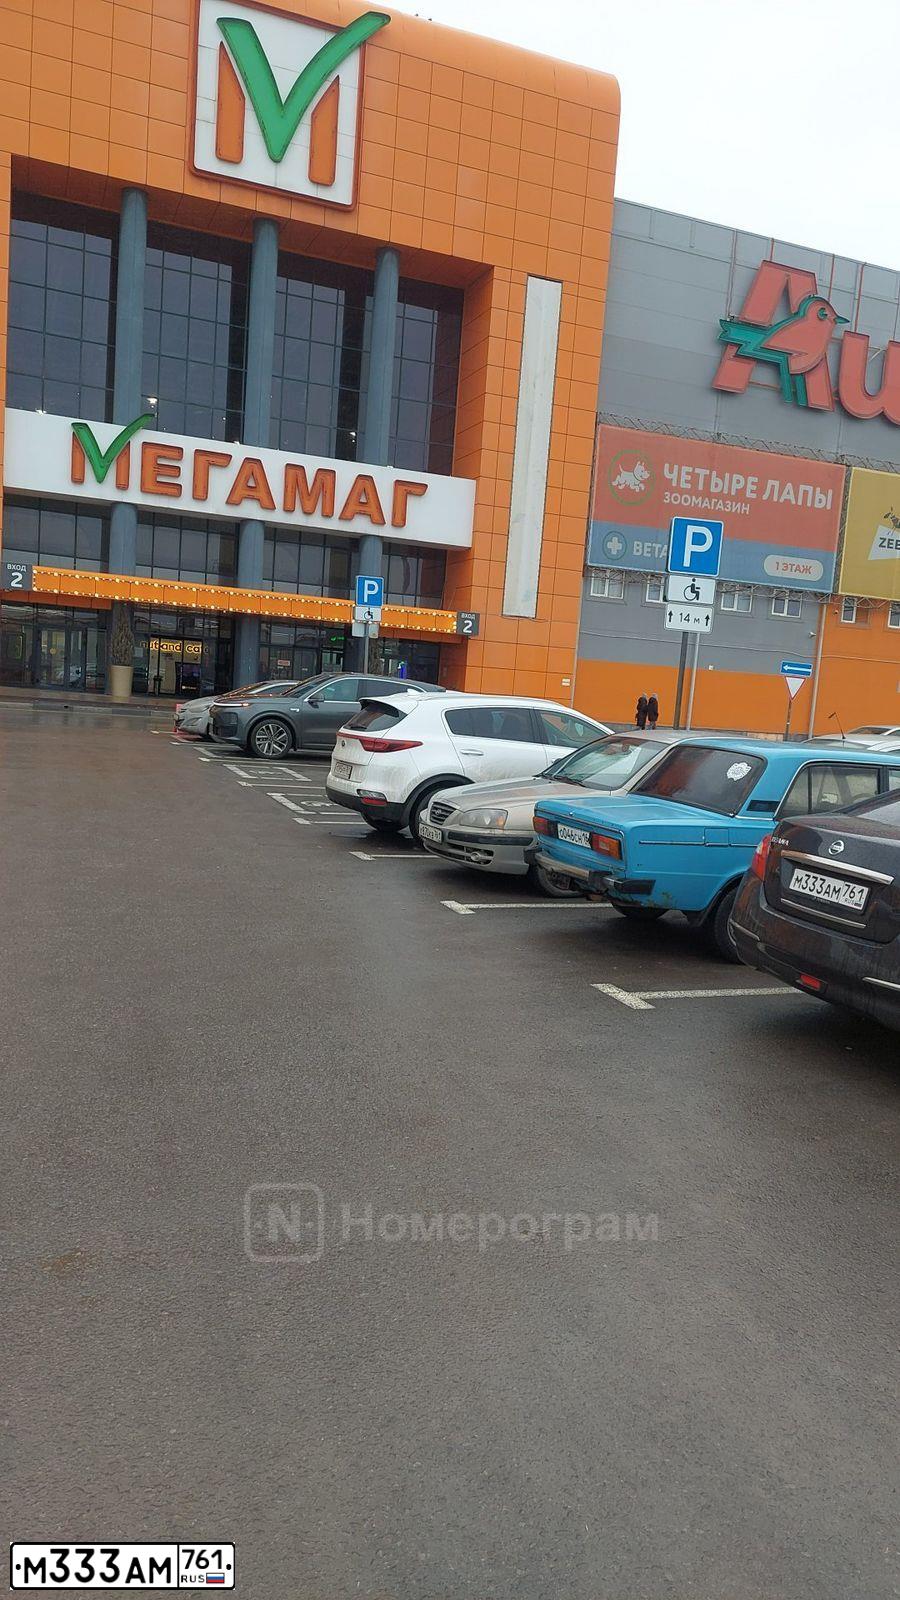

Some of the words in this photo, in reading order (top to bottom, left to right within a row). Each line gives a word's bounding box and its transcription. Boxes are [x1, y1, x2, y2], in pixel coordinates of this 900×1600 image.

[71, 413, 428, 528] МЕГАМАГ
[663, 463, 758, 499] ЧЕТЫРЕ
[762, 479, 833, 510] ЛАПЫ
[663, 491, 750, 515] ЗООМАГАЗИН
[683, 525, 713, 567] P
[7, 563, 27, 572] ВХОД
[781, 562, 812, 575] ЭТАЖ
[10, 572, 22, 588] 2
[364, 579, 379, 603] P
[461, 612, 476, 620] ВХОД
[679, 612, 690, 623] 14
[462, 620, 473, 633] 2
[160, 642, 182, 652] and
[793, 873, 842, 900] М333АМ
[843, 883, 865, 902] 761
